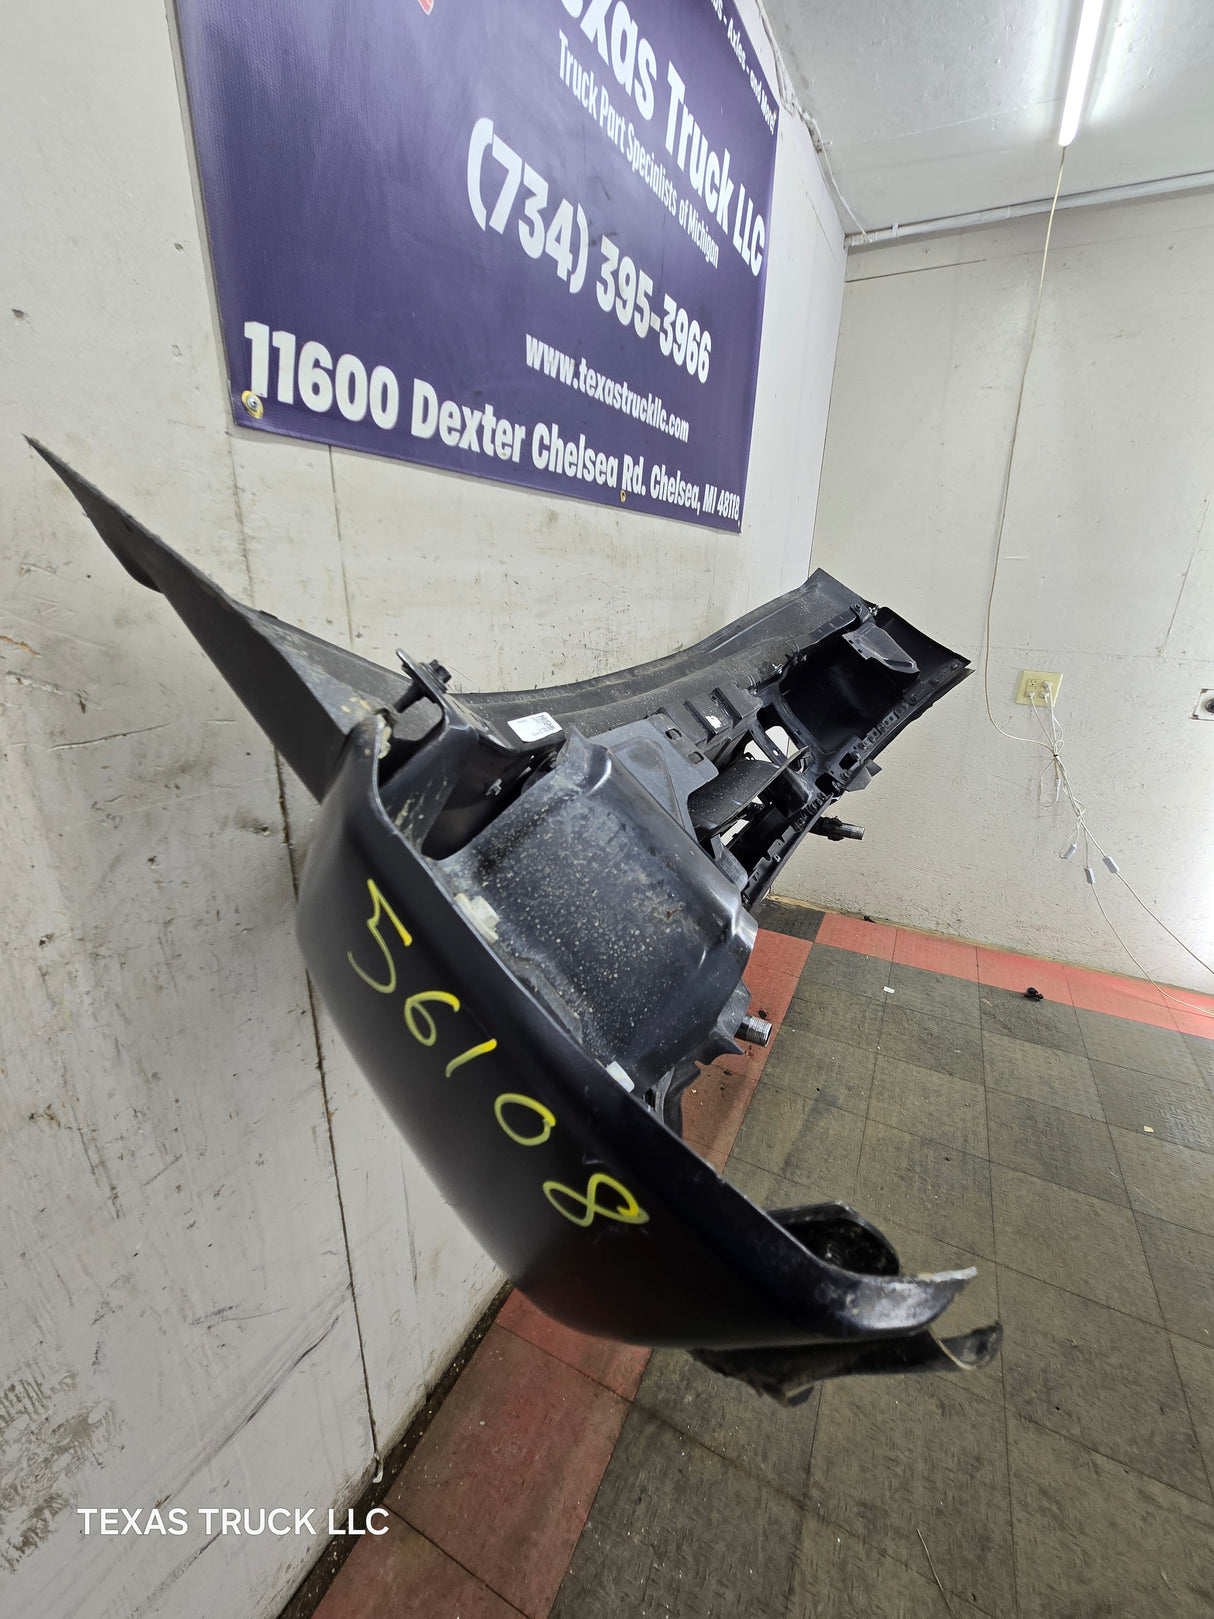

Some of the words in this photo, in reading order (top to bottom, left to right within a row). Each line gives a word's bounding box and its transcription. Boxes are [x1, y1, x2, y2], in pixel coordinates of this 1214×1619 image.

[467, 117, 589, 294] (734)
[596, 235, 711, 384] 395-3966
[559, 28, 598, 121] Truck
[599, 85, 627, 154] Part
[626, 122, 677, 216] Specialists
[678, 198, 689, 230] of
[687, 204, 719, 269] Michigan
[665, 60, 735, 235] Truck
[733, 183, 766, 276] LLC
[244, 321, 399, 430] 11600
[411, 378, 526, 463] Dexter
[531, 422, 619, 488] Chelsea
[621, 453, 646, 496] Rd.
[650, 464, 700, 516] Chelsea,
[702, 483, 717, 514] MI
[717, 489, 740, 521] 48118
[525, 333, 689, 443] www.texastruckllc.com
